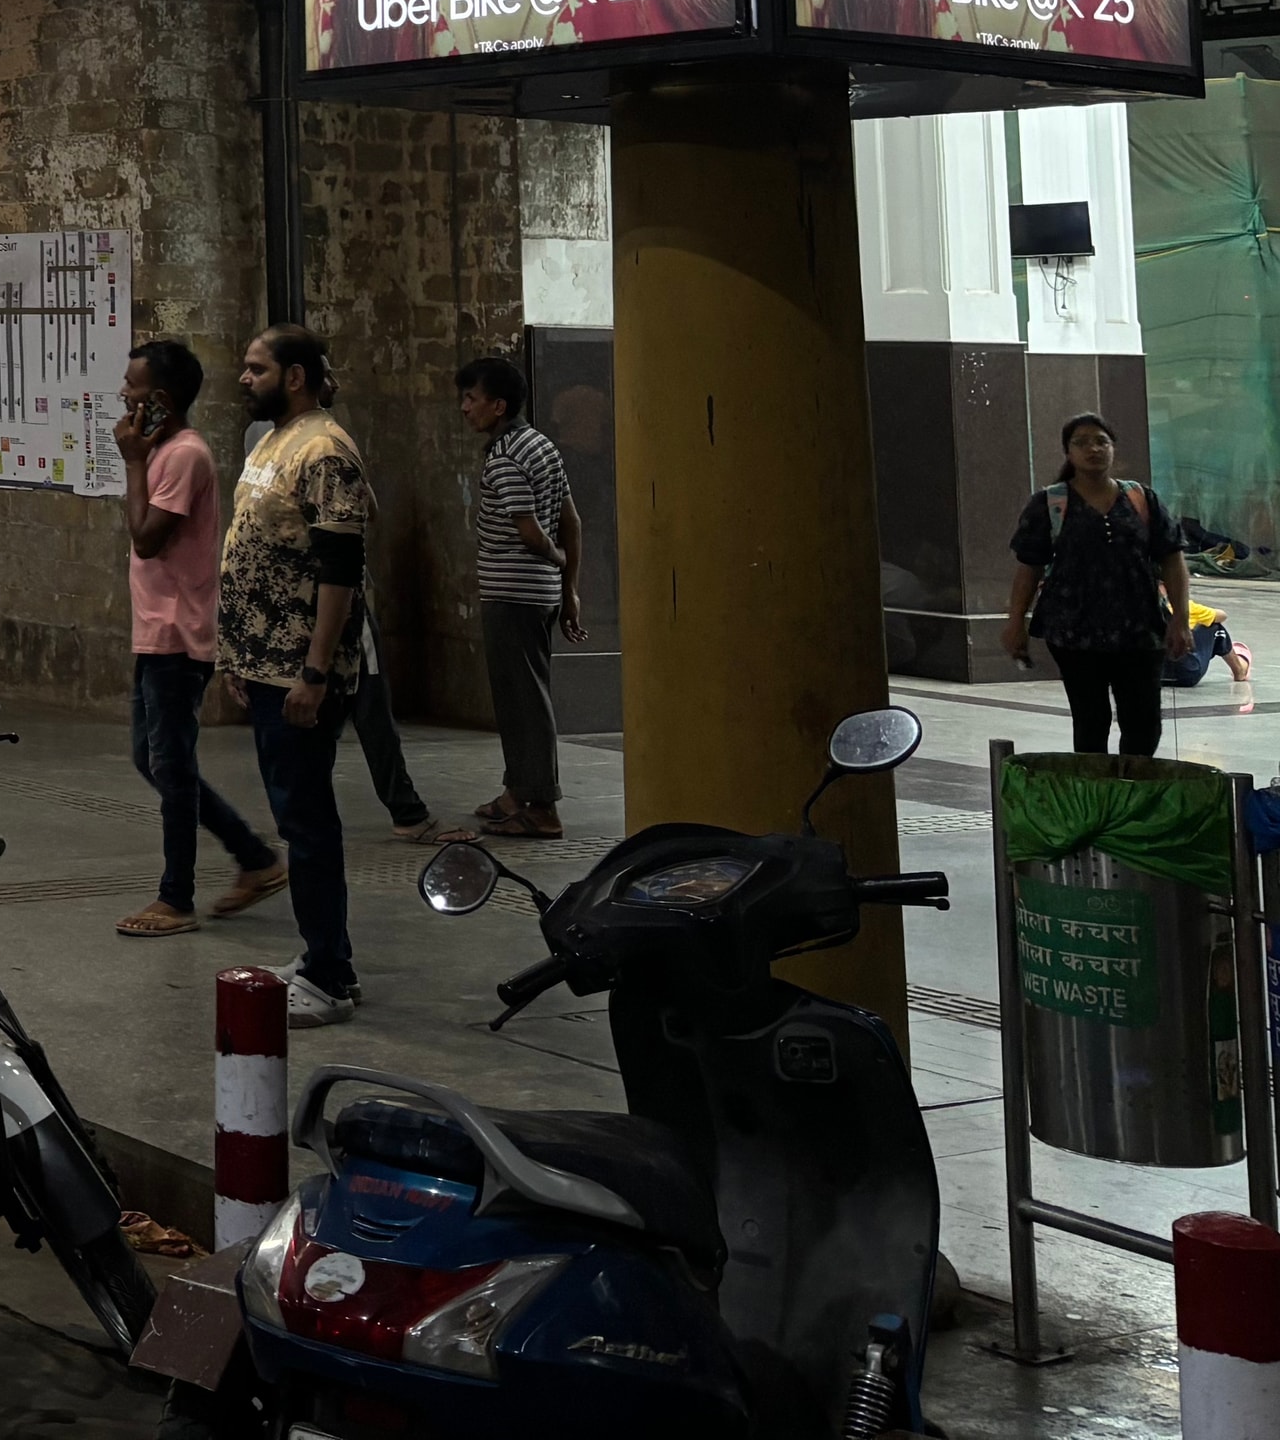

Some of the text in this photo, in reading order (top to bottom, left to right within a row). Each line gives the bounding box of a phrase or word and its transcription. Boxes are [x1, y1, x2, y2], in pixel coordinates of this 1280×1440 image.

[1057, 918, 1141, 945] कचरा
[1058, 950, 1142, 978] कचरा
[1022, 970, 1049, 995] WET
[1053, 979, 1128, 1009] WASTE
